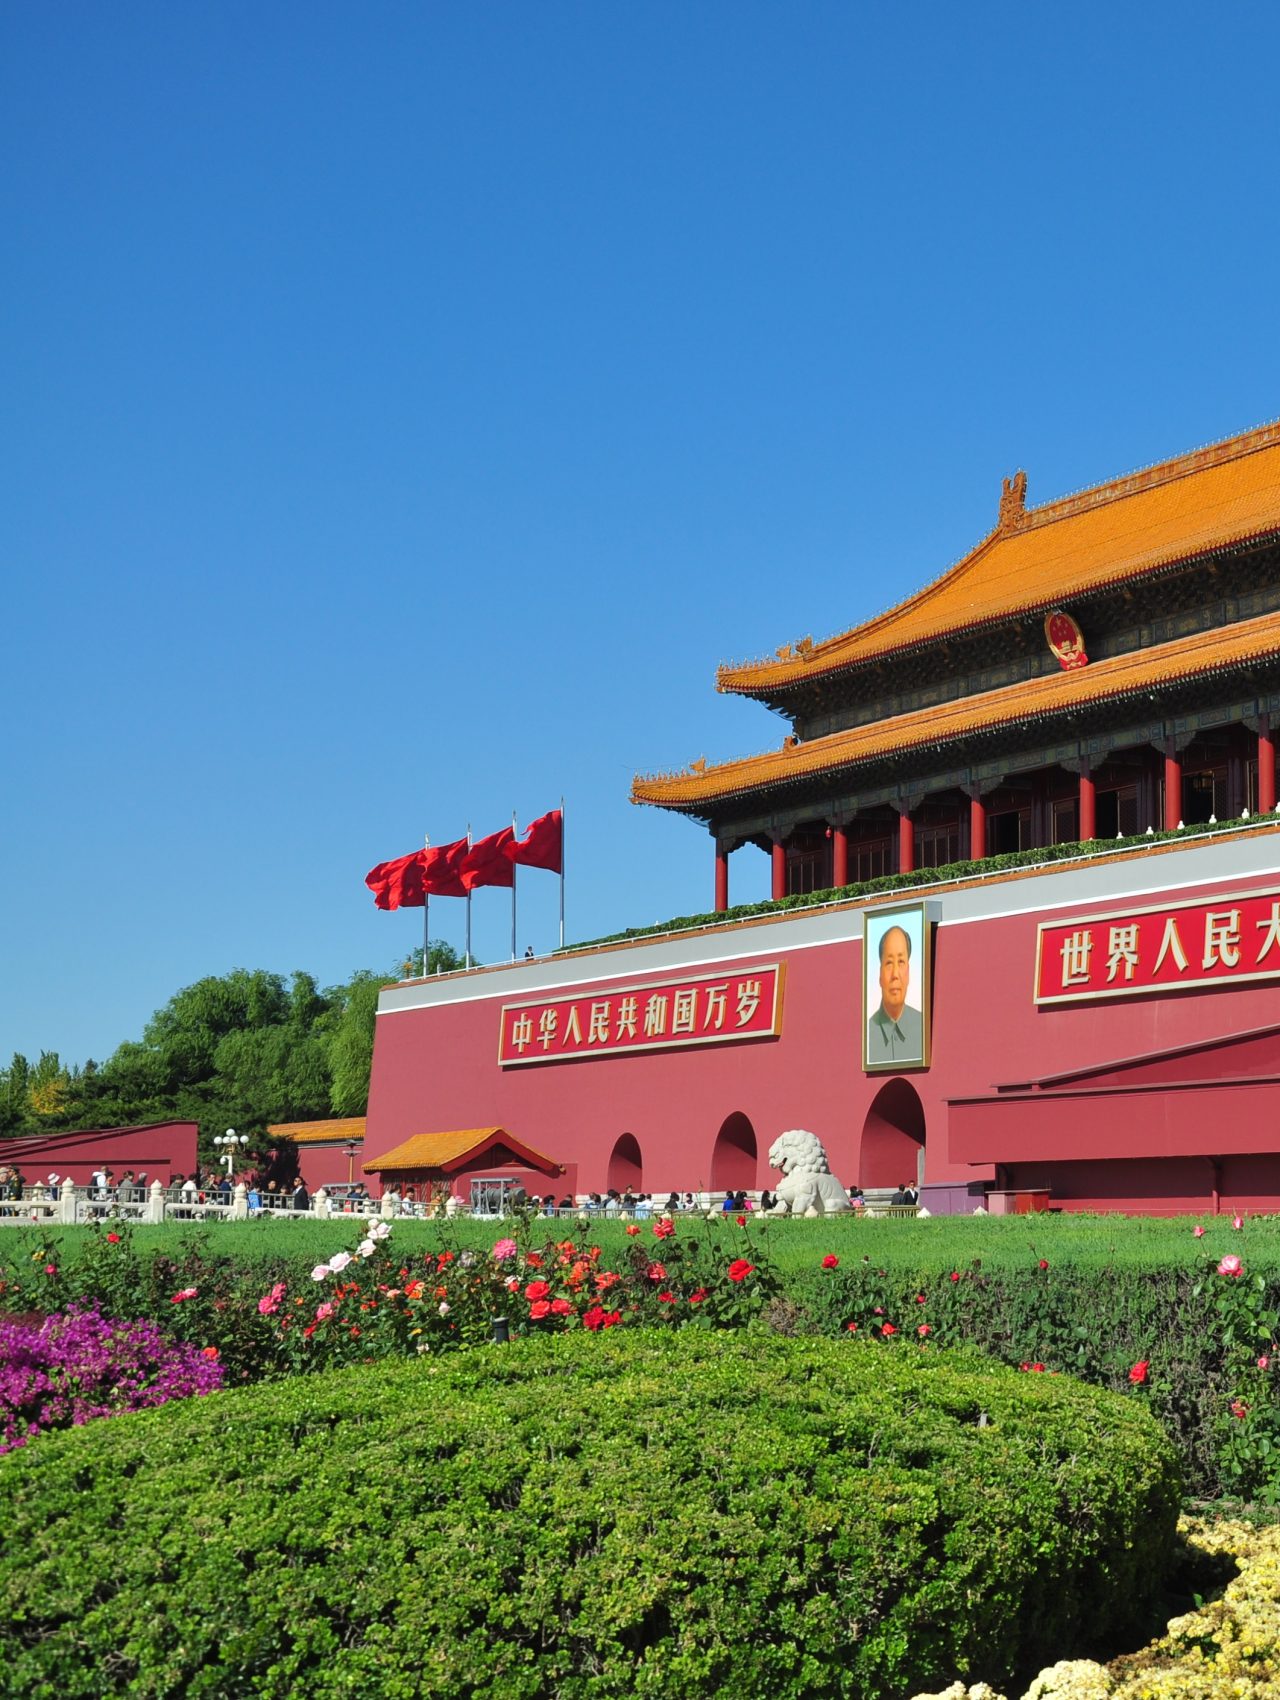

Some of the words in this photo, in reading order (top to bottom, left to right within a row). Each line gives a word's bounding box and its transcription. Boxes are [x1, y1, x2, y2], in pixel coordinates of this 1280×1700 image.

[511, 980, 762, 1053] 中华人民共和国万岁
